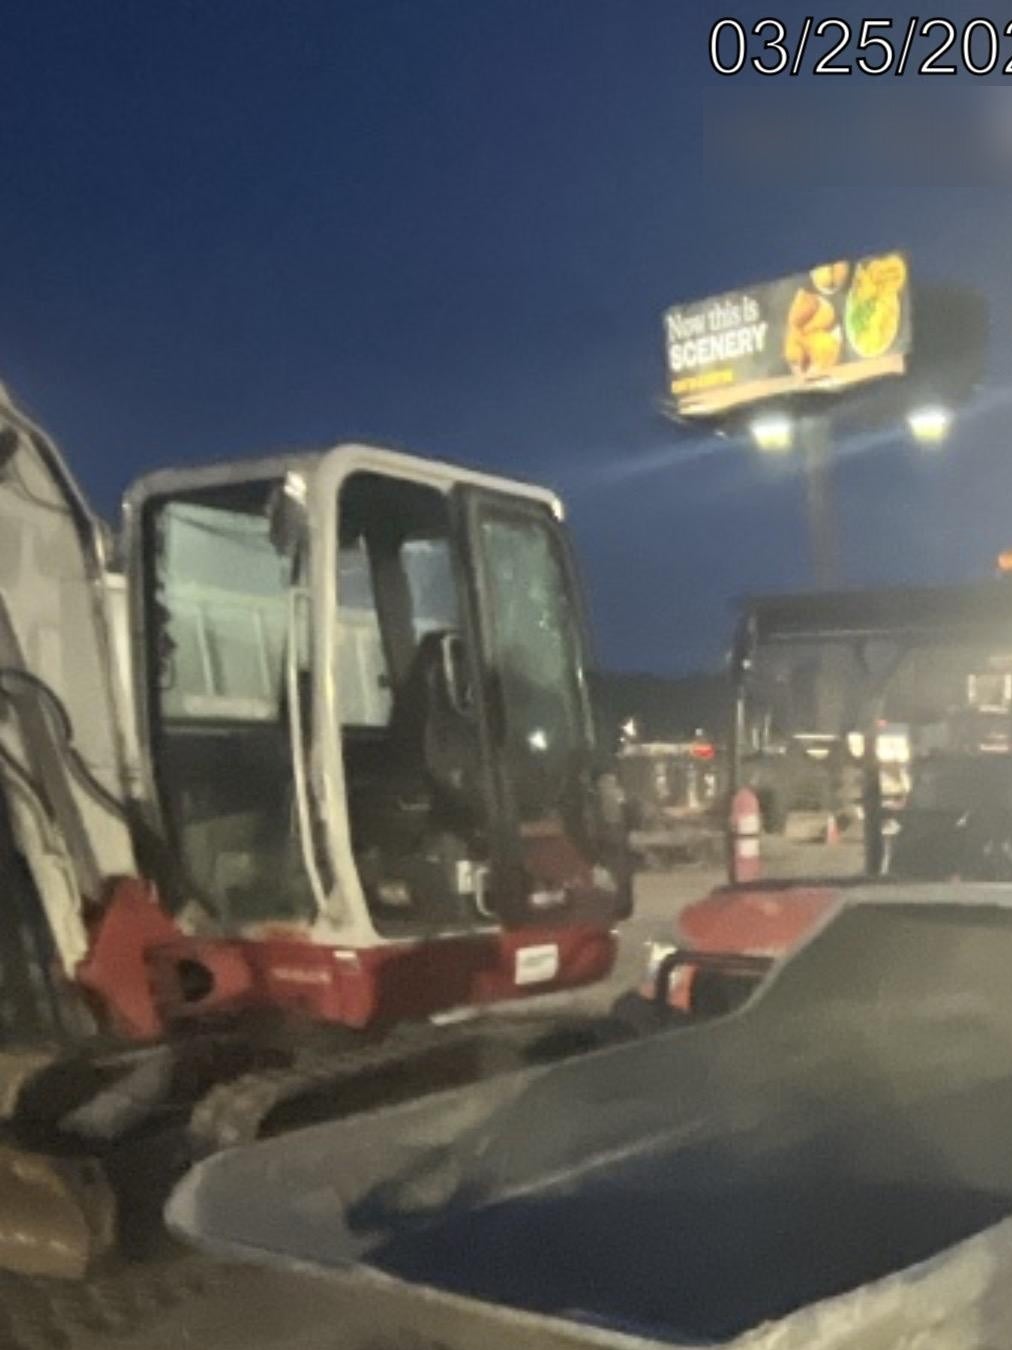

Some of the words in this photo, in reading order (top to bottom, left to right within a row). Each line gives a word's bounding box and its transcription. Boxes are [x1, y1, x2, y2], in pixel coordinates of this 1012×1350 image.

[667, 311, 706, 343] Now
[708, 300, 742, 331] this
[742, 296, 761, 321] is
[670, 323, 767, 372] SCENERY
